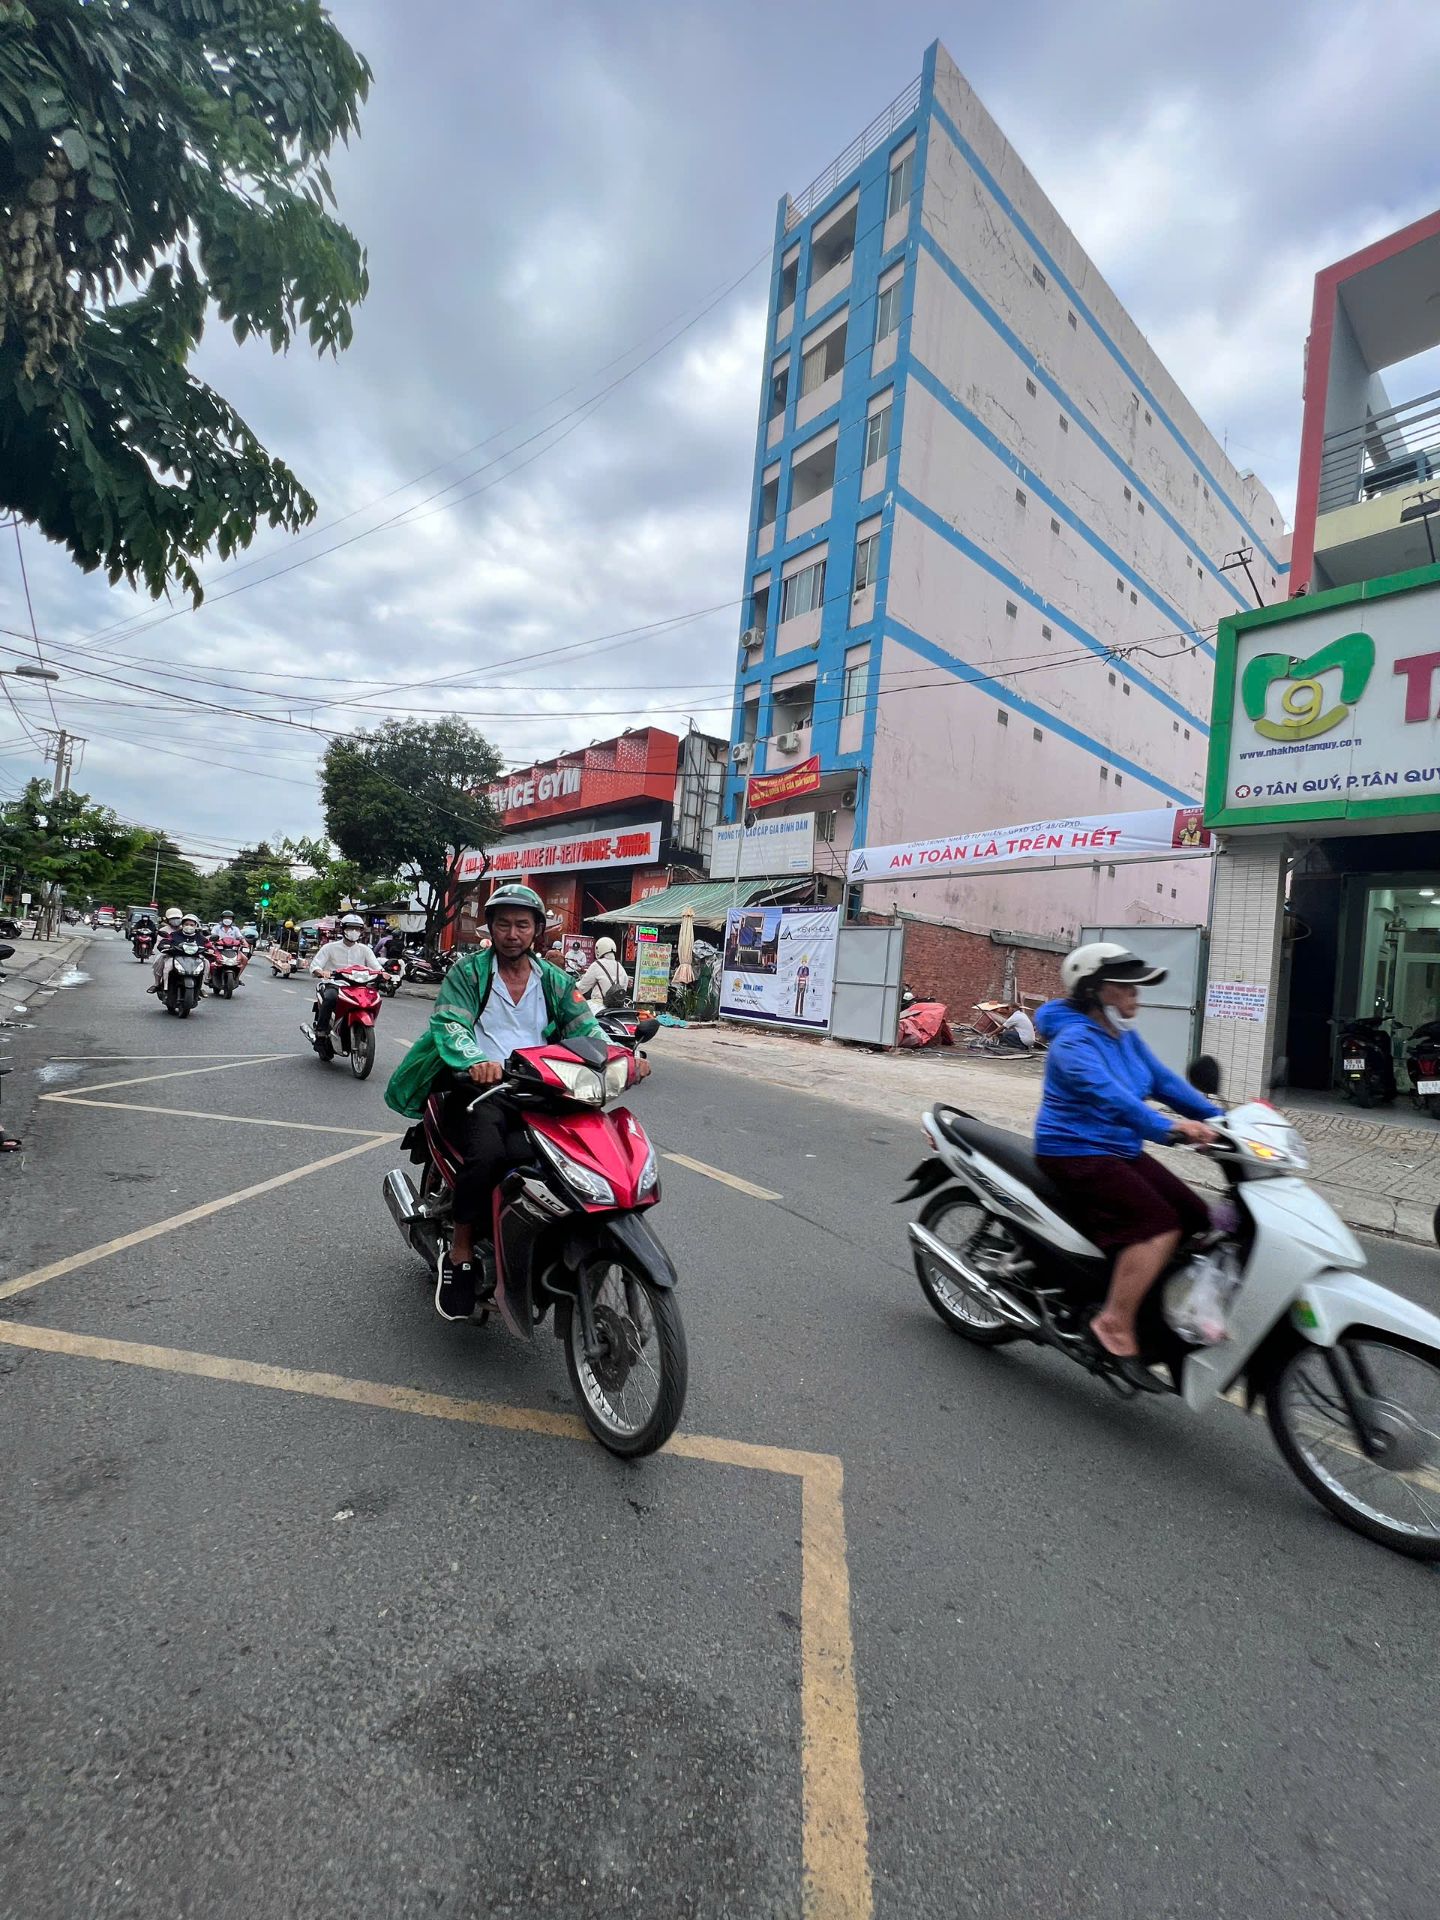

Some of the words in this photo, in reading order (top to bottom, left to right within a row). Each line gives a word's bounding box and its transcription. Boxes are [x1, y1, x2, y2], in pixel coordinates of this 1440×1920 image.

[1393, 651, 1440, 723] T
[538, 768, 581, 801] GYM
[1253, 785, 1262, 797] 9
[1266, 781, 1297, 796] TÂN
[889, 853, 913, 869] AN
[919, 845, 968, 864] TOÀN
[973, 839, 999, 858] LÀ
[1006, 833, 1064, 854] TRÊN
[1071, 825, 1121, 848] HẾT
